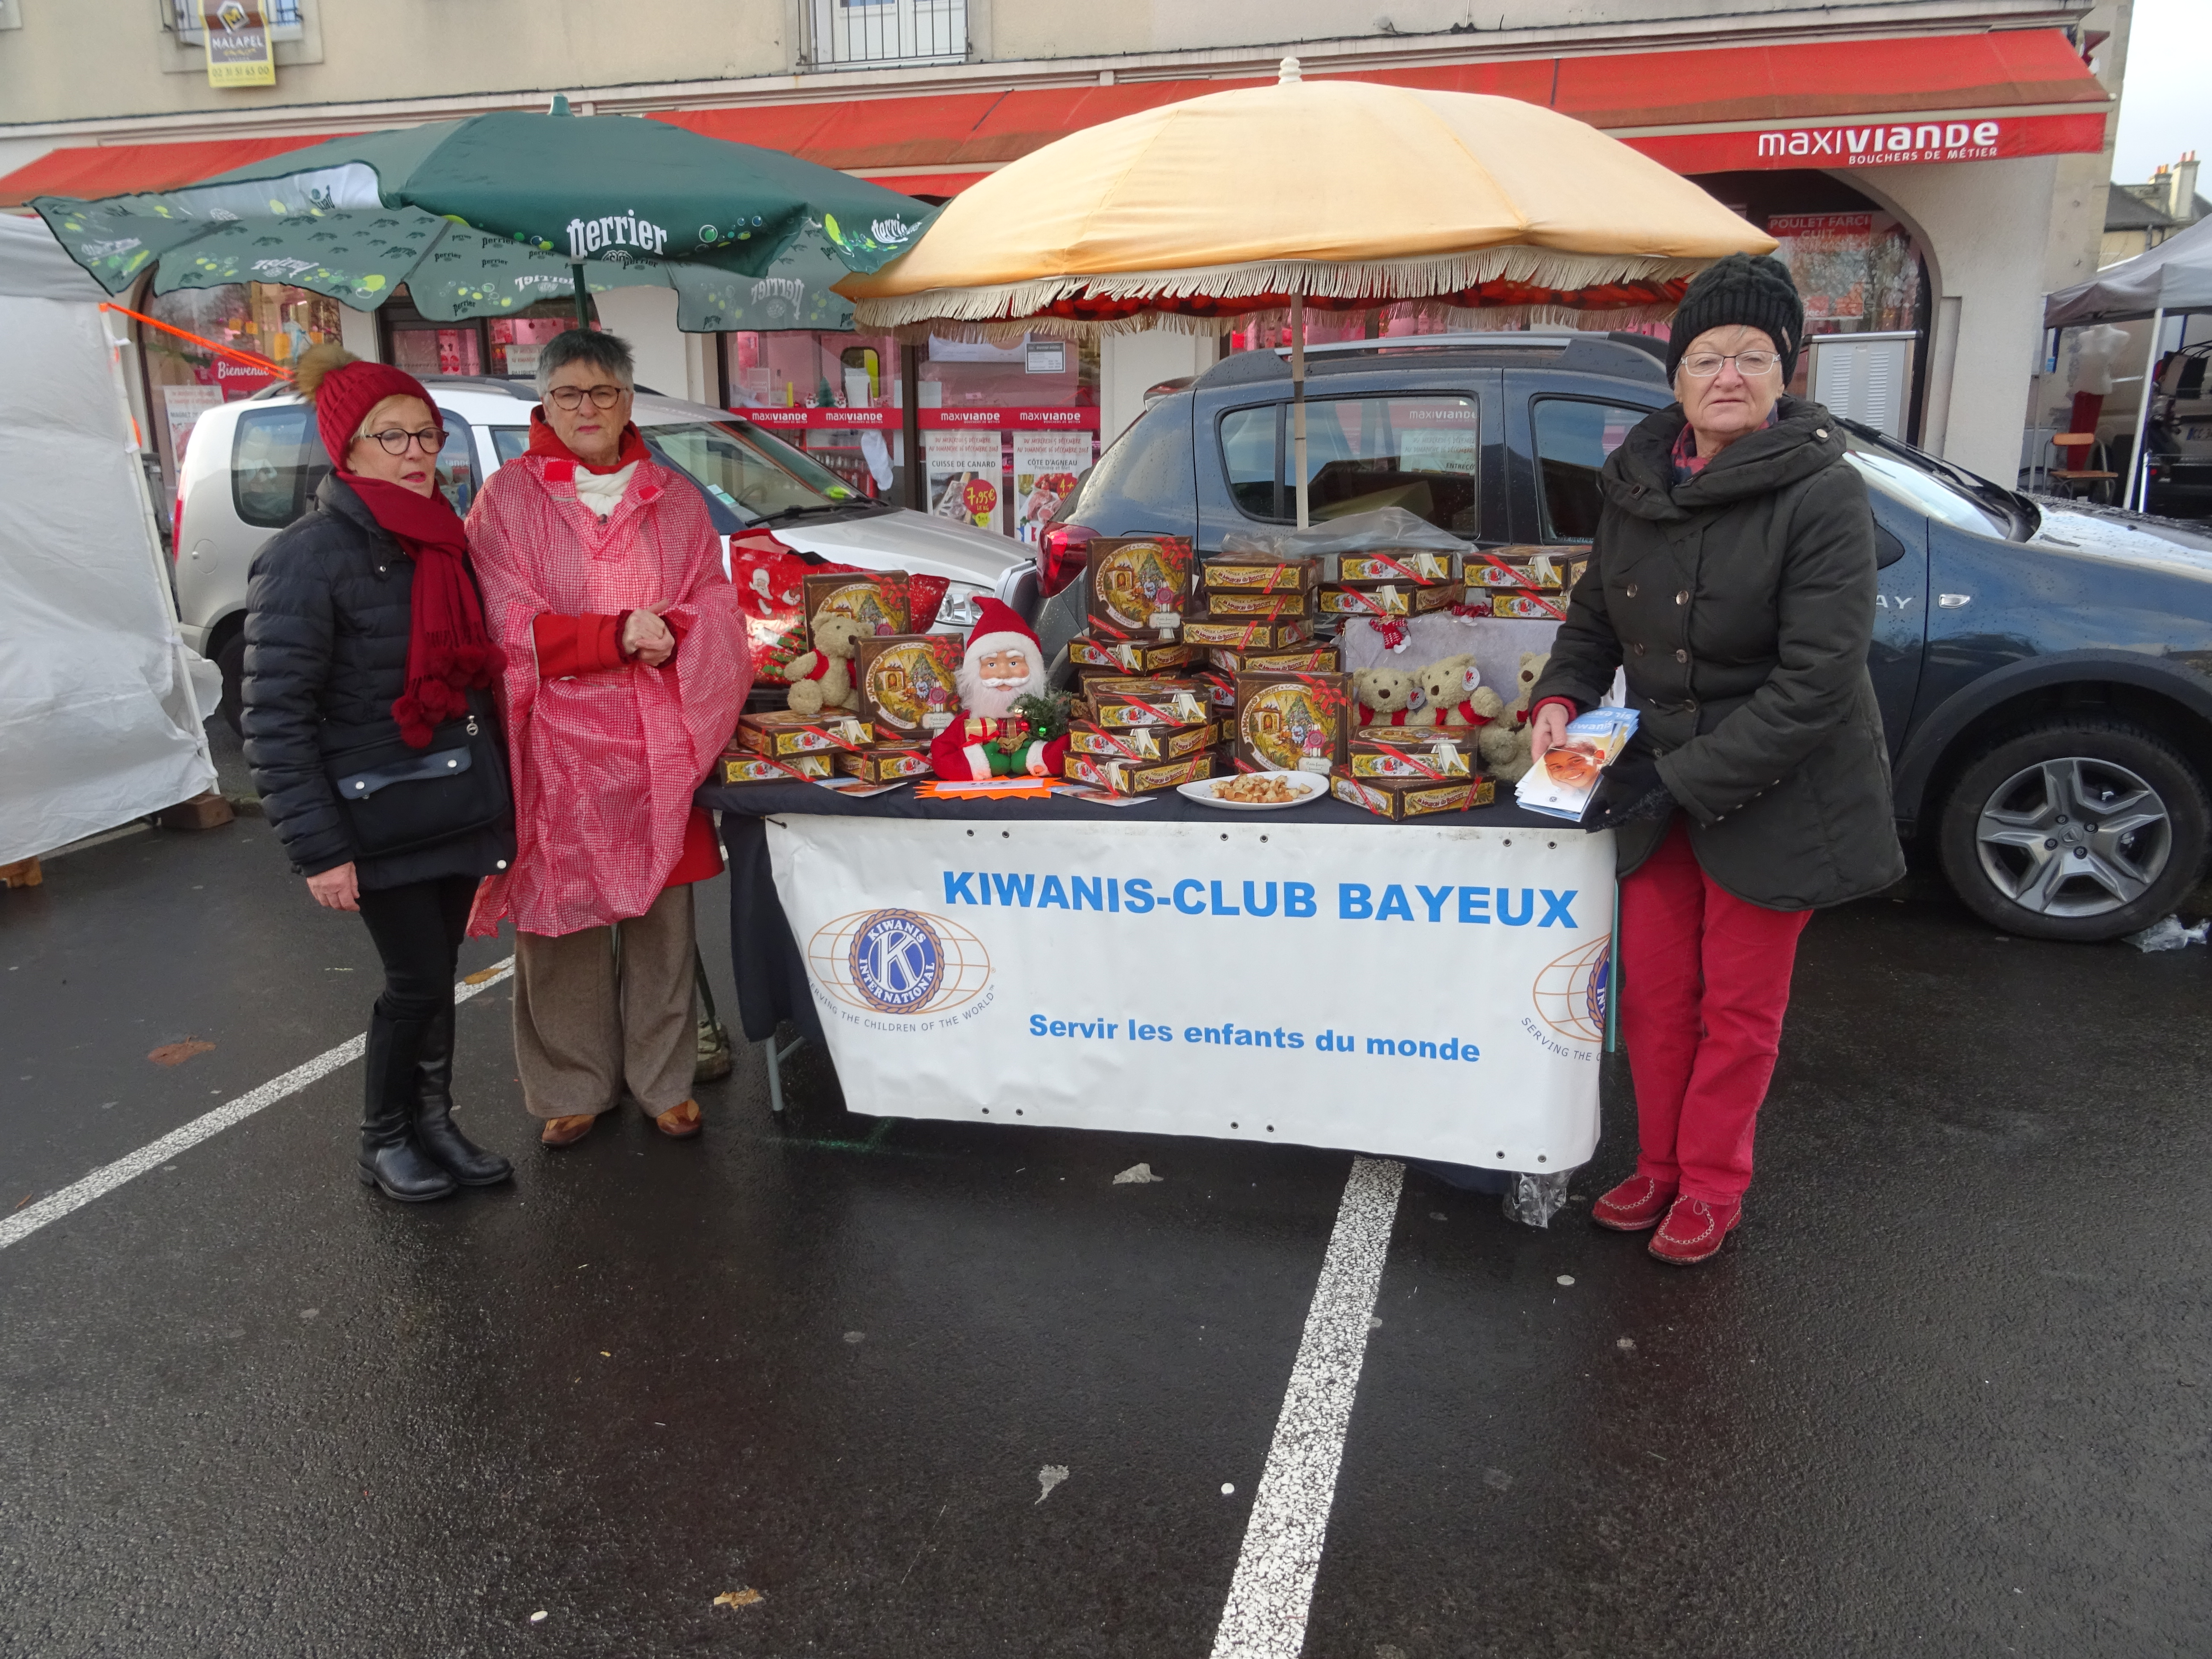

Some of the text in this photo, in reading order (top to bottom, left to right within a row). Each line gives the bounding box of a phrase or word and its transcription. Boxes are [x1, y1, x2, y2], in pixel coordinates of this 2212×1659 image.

[1849, 146, 1997, 165] BOUCHERS DE MÉTIER
[1769, 215, 1869, 229] POULET FARCI
[1801, 230, 1834, 239] CUIT
[943, 870, 1579, 928] KIWANIS-CLUB BAYEUX
[867, 919, 927, 943] KIWANIS
[859, 958, 935, 1004] INTERNATIONAL
[809, 983, 838, 1015] ERVING
[841, 1011, 860, 1024] THE
[864, 1019, 916, 1032] CHILDREN
[922, 1022, 934, 1031] OF
[939, 1016, 959, 1029] THE
[1030, 1014, 1480, 1062] Servir les enfants du monde
[1521, 1017, 1592, 1061] SERVING THE
